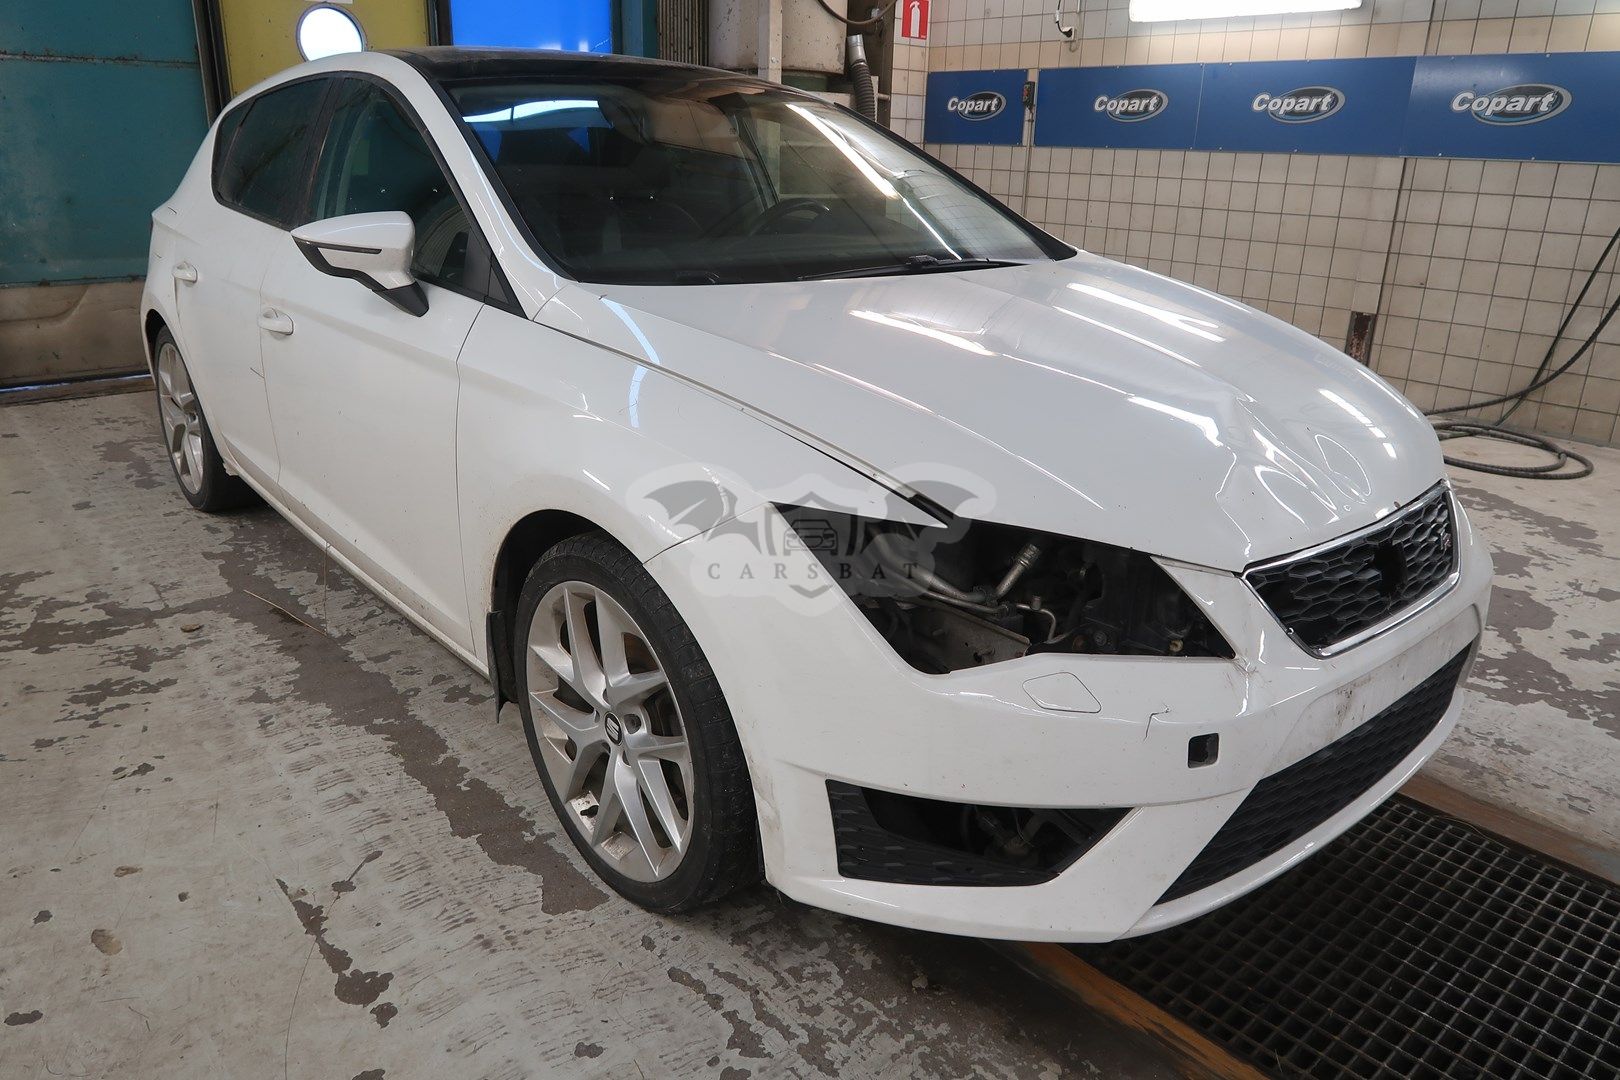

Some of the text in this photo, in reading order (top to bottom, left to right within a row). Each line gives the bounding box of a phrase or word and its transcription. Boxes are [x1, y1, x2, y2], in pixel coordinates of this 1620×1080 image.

[947, 96, 999, 114] Copart
[1094, 95, 1159, 115] Copart
[1252, 93, 1334, 115] Copart
[1452, 91, 1556, 116] Copart
